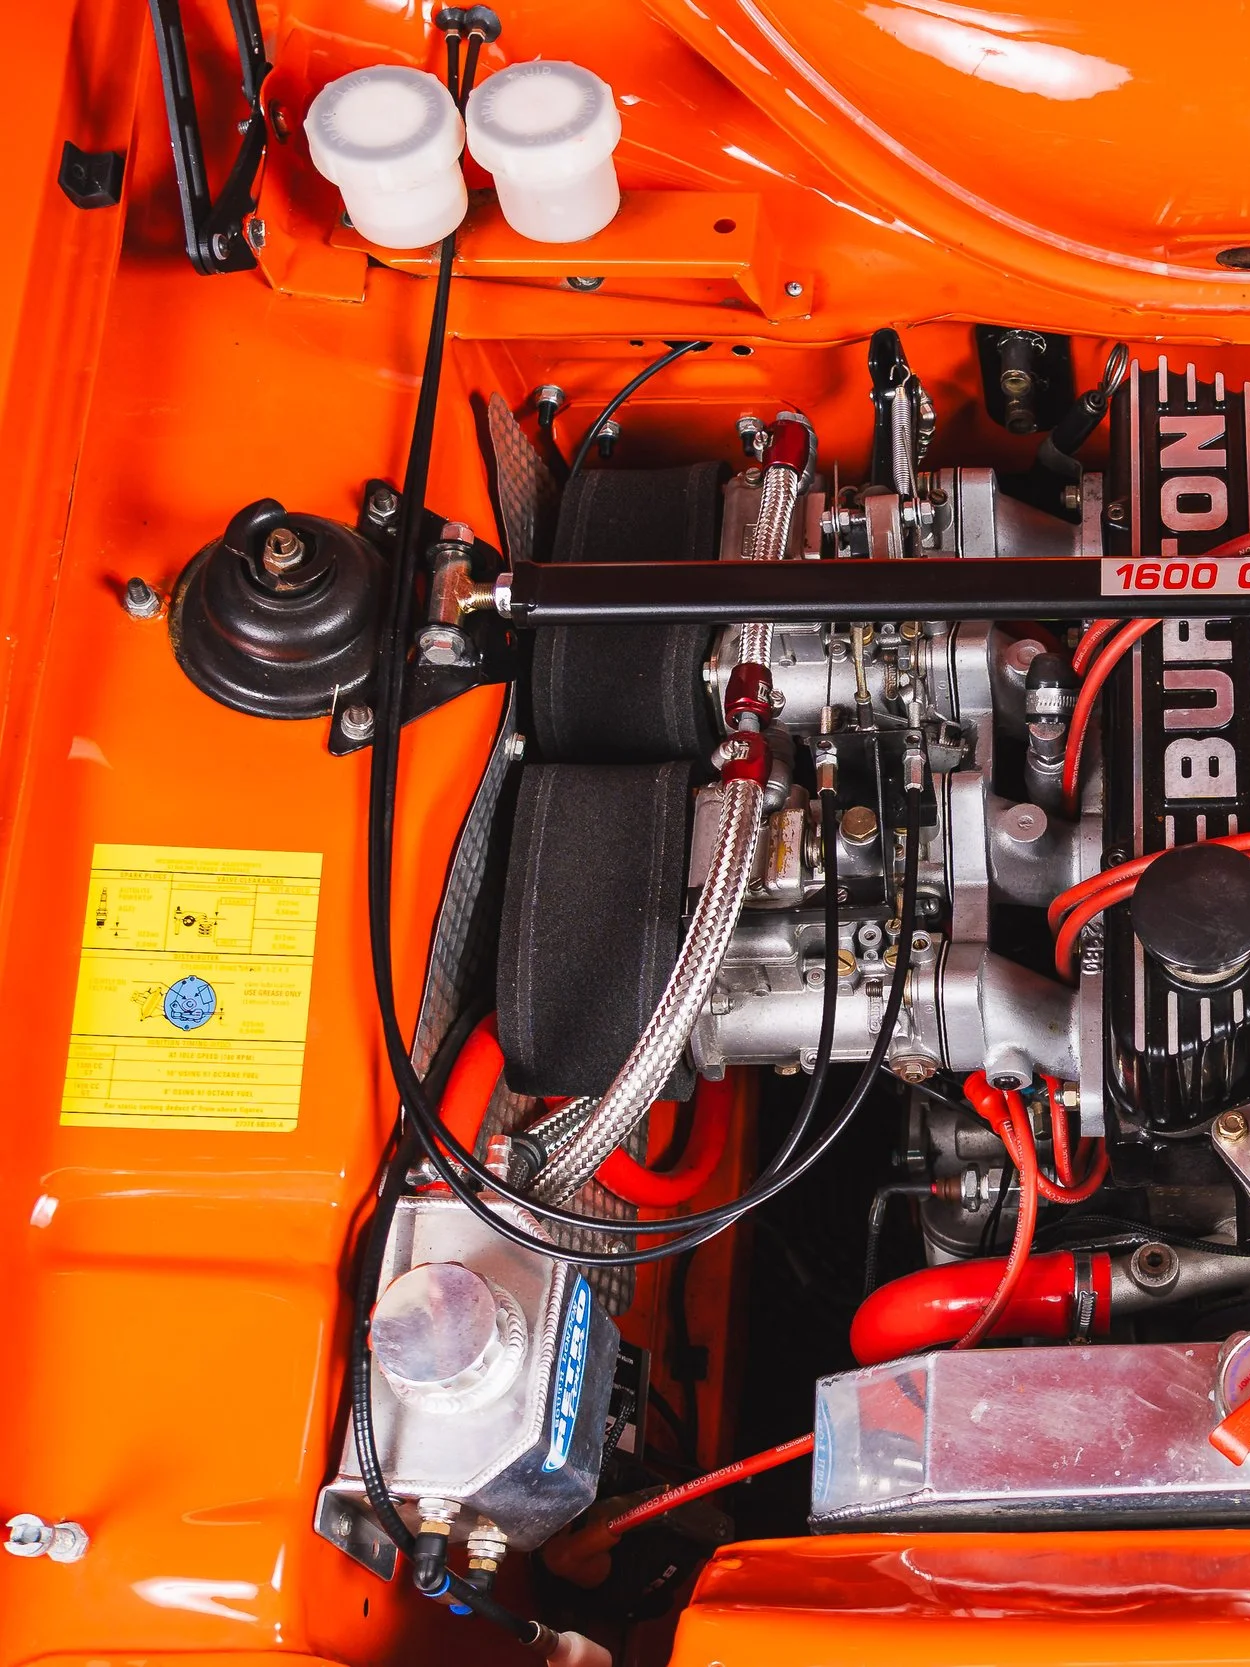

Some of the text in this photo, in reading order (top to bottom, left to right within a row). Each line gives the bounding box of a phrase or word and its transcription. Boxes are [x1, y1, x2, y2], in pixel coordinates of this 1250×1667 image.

[1115, 562, 1218, 590] 1600
[1158, 415, 1237, 799] BURON
[242, 988, 302, 998] USE GREASE ONLY
[555, 1288, 587, 1454] RETRO
[1238, 1375, 1250, 1391] HOT
[775, 1434, 812, 1453] CONDUCTOR
[686, 1461, 744, 1490] MAGNECOR
[661, 1484, 686, 1503] KV85
